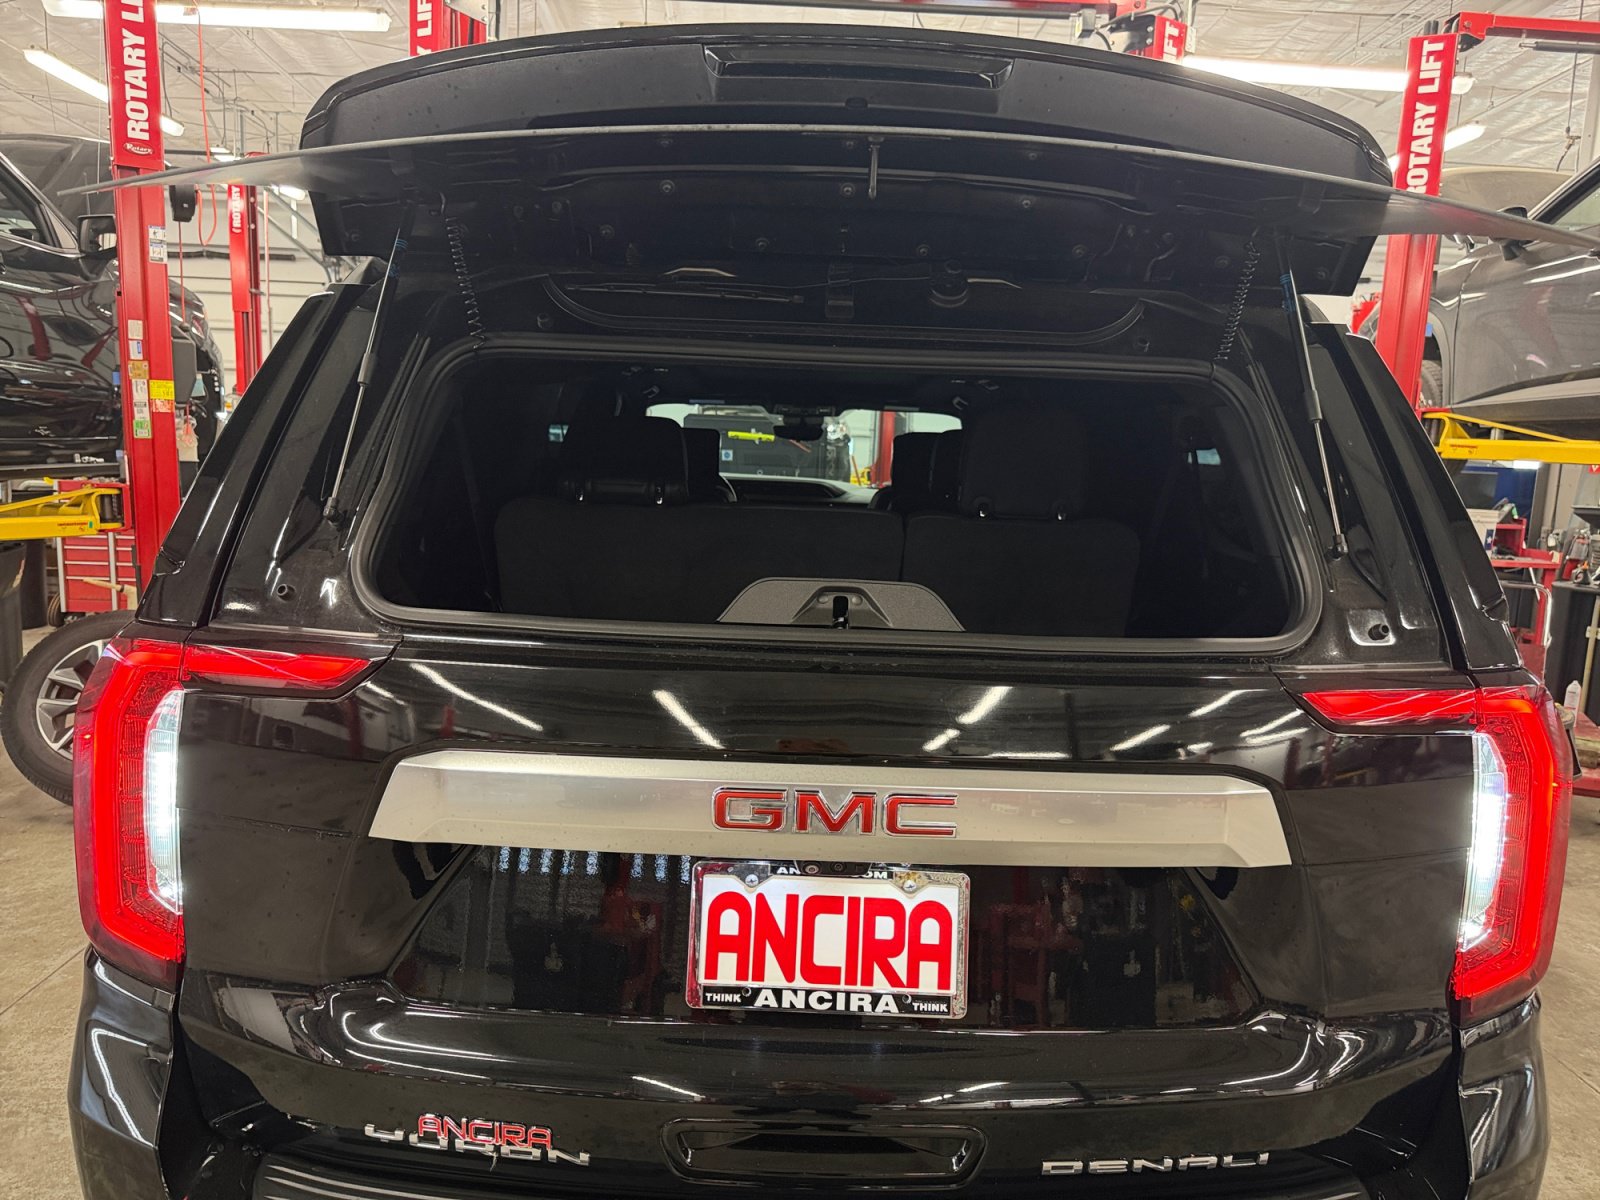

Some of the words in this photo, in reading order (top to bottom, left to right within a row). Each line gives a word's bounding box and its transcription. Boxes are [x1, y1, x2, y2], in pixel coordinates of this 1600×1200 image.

[416, 0, 432, 37] LIF
[1162, 20, 1179, 63] IFT
[122, 28, 150, 141] ROTARY
[1417, 39, 1445, 94] LIFT
[231, 185, 242, 228] ROTARY
[712, 786, 959, 838] GMC
[704, 891, 953, 990] ANCIRA
[706, 992, 742, 1003] THINK
[754, 988, 900, 1014] ANCIRA
[912, 1002, 949, 1013] THINK
[417, 1113, 553, 1151] ANCIRA
[1041, 1151, 1270, 1176] DENALI
